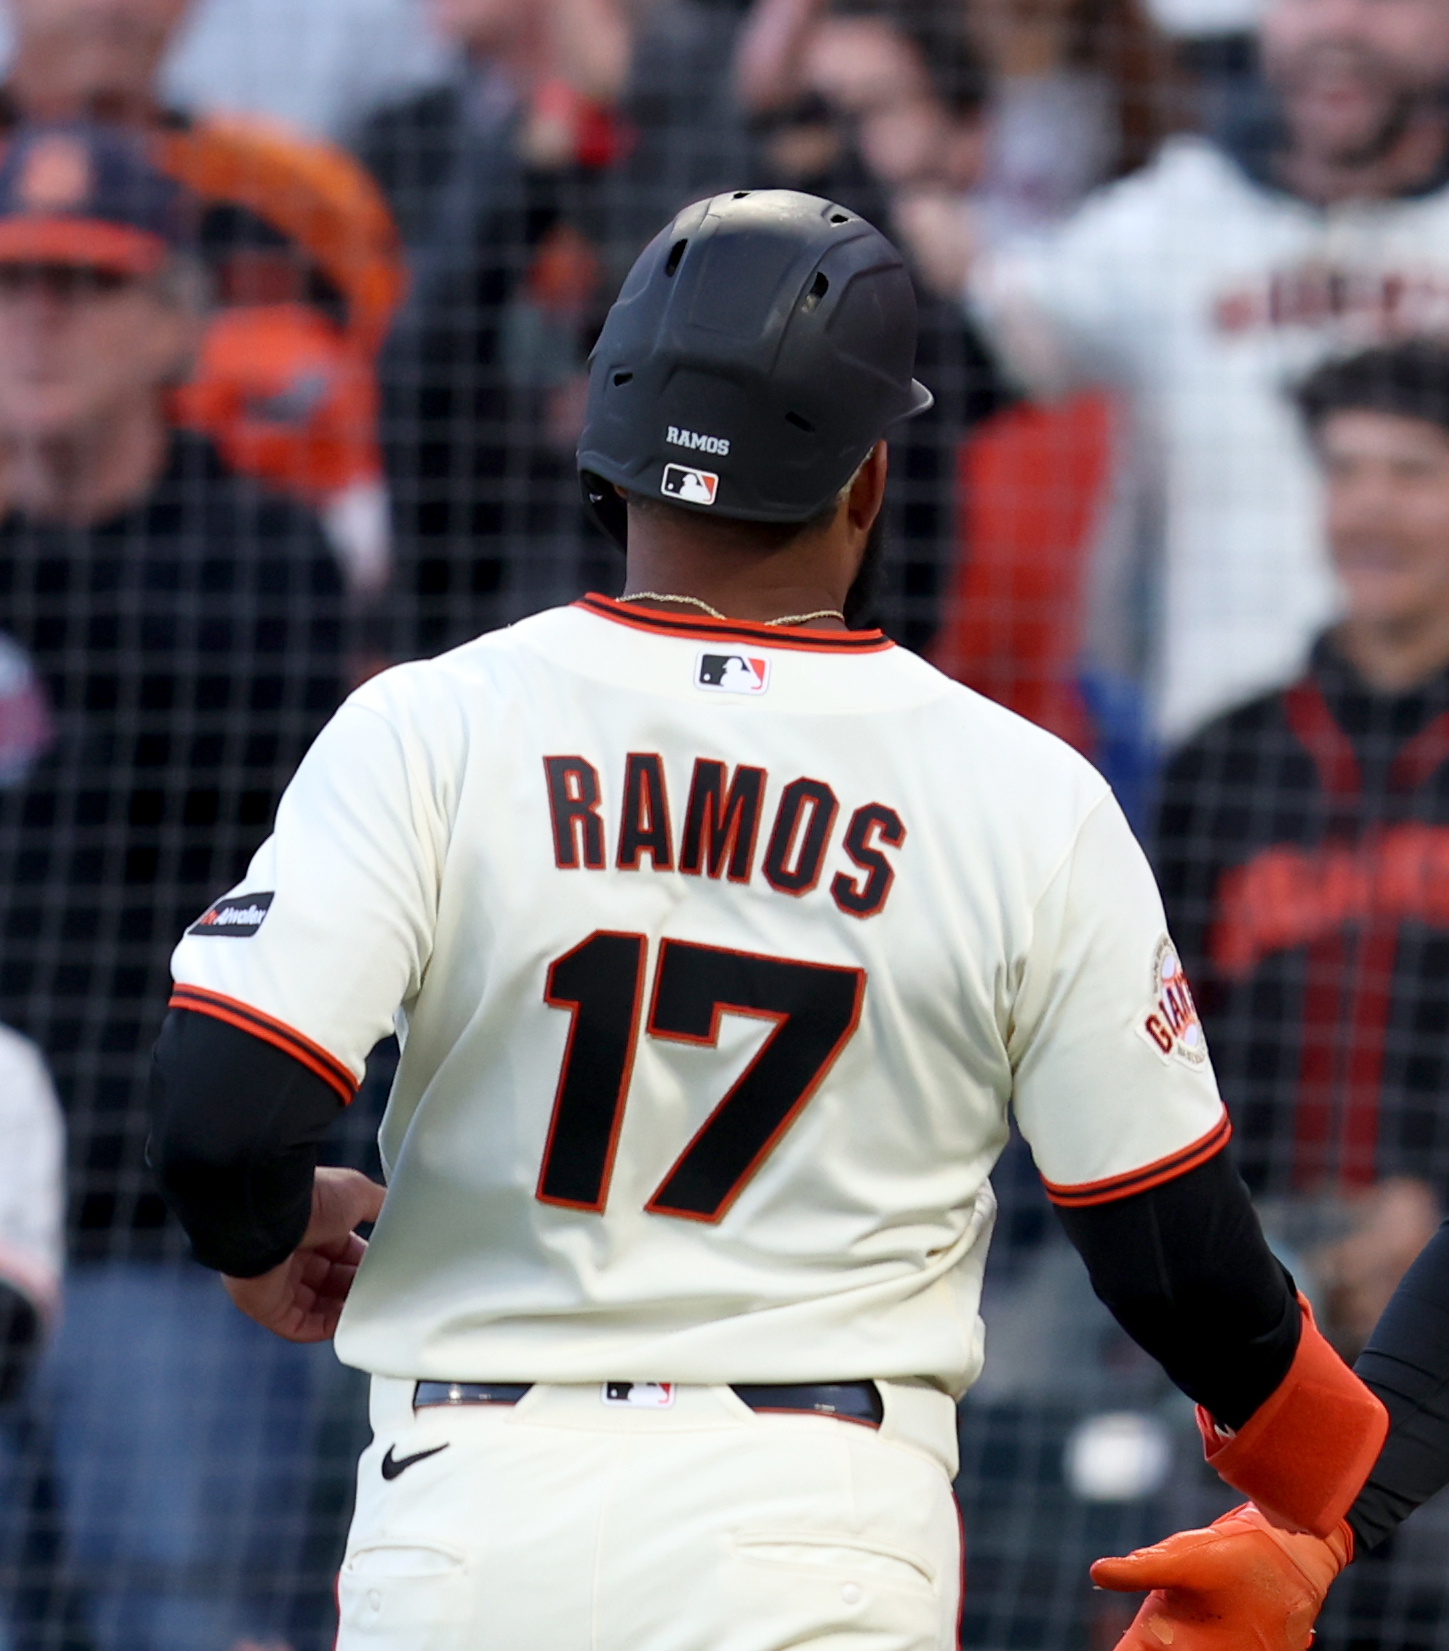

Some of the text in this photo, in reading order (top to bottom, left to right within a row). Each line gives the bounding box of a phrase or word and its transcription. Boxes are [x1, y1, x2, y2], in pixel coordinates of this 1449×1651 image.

[666, 425, 731, 456] RAMOS
[542, 752, 907, 920] RAMOS
[534, 929, 867, 1226] 17
